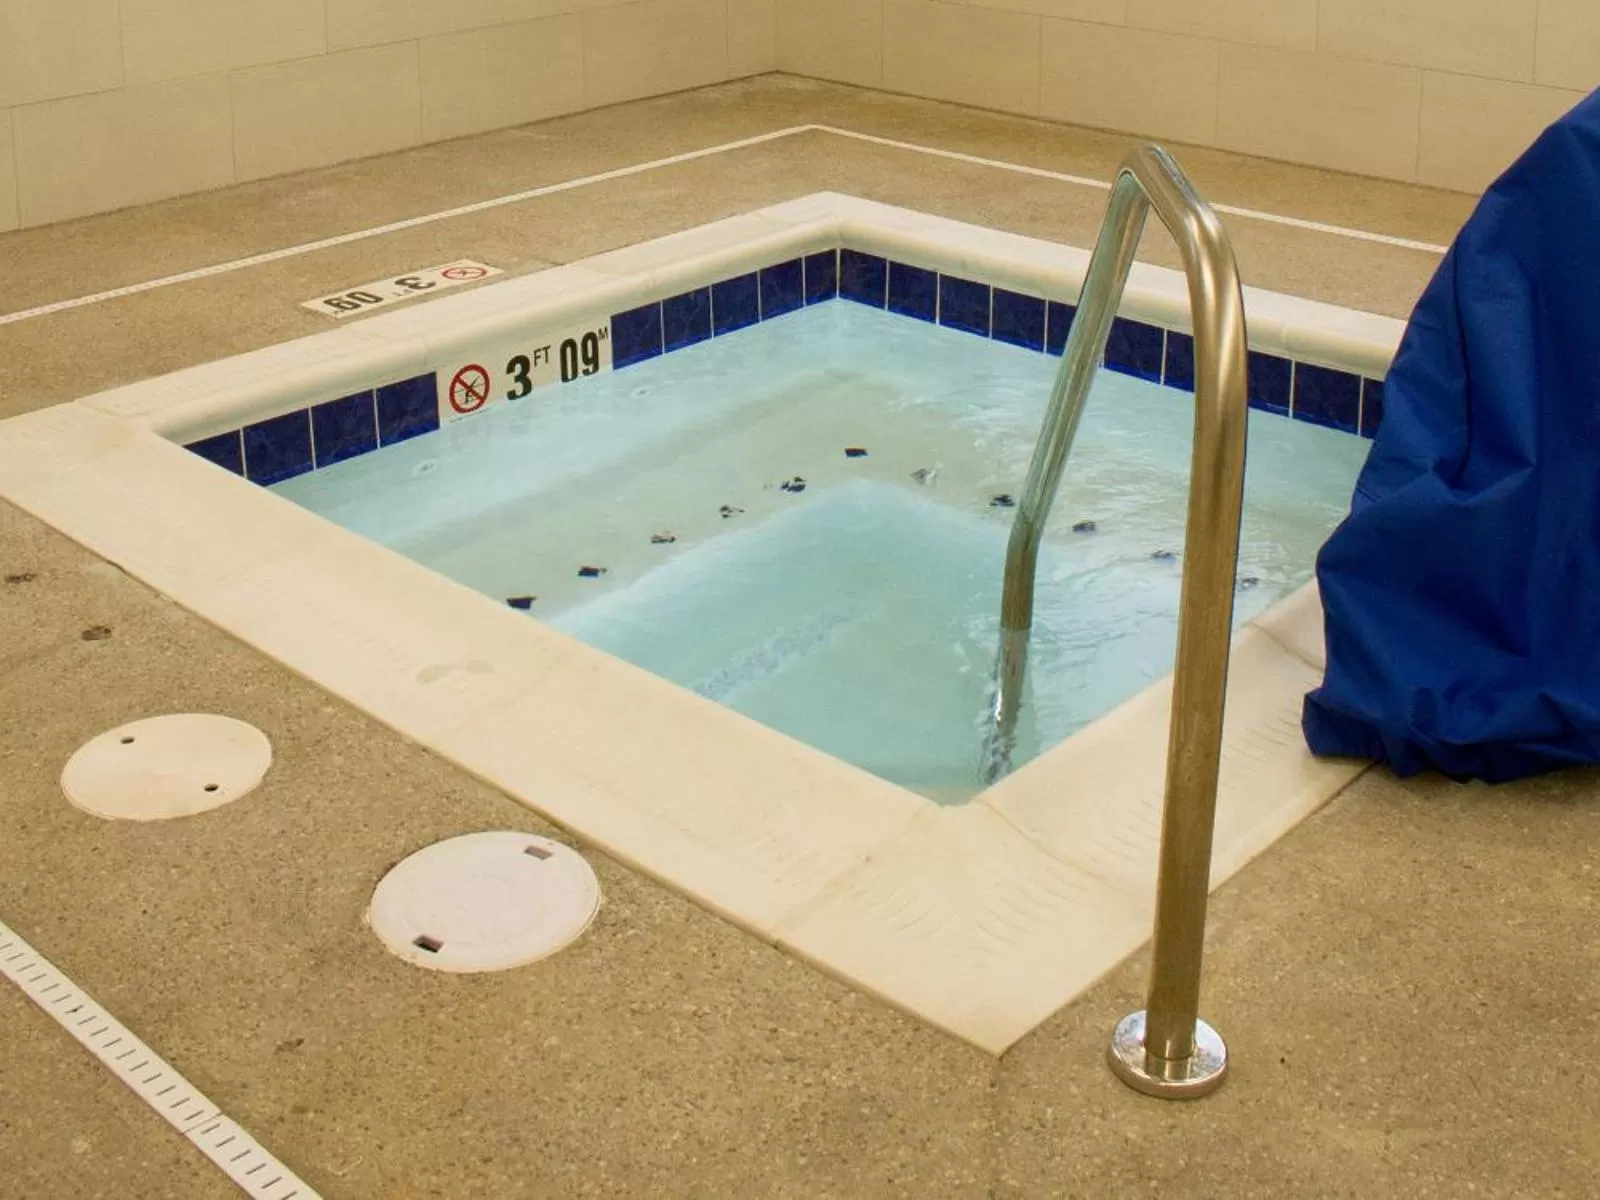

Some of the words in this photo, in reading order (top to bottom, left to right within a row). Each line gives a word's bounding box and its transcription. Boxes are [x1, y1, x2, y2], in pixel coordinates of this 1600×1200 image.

[395, 277, 436, 290] 3
[506, 355, 532, 400] 3
[533, 345, 551, 366] FT
[560, 331, 600, 383] 09
